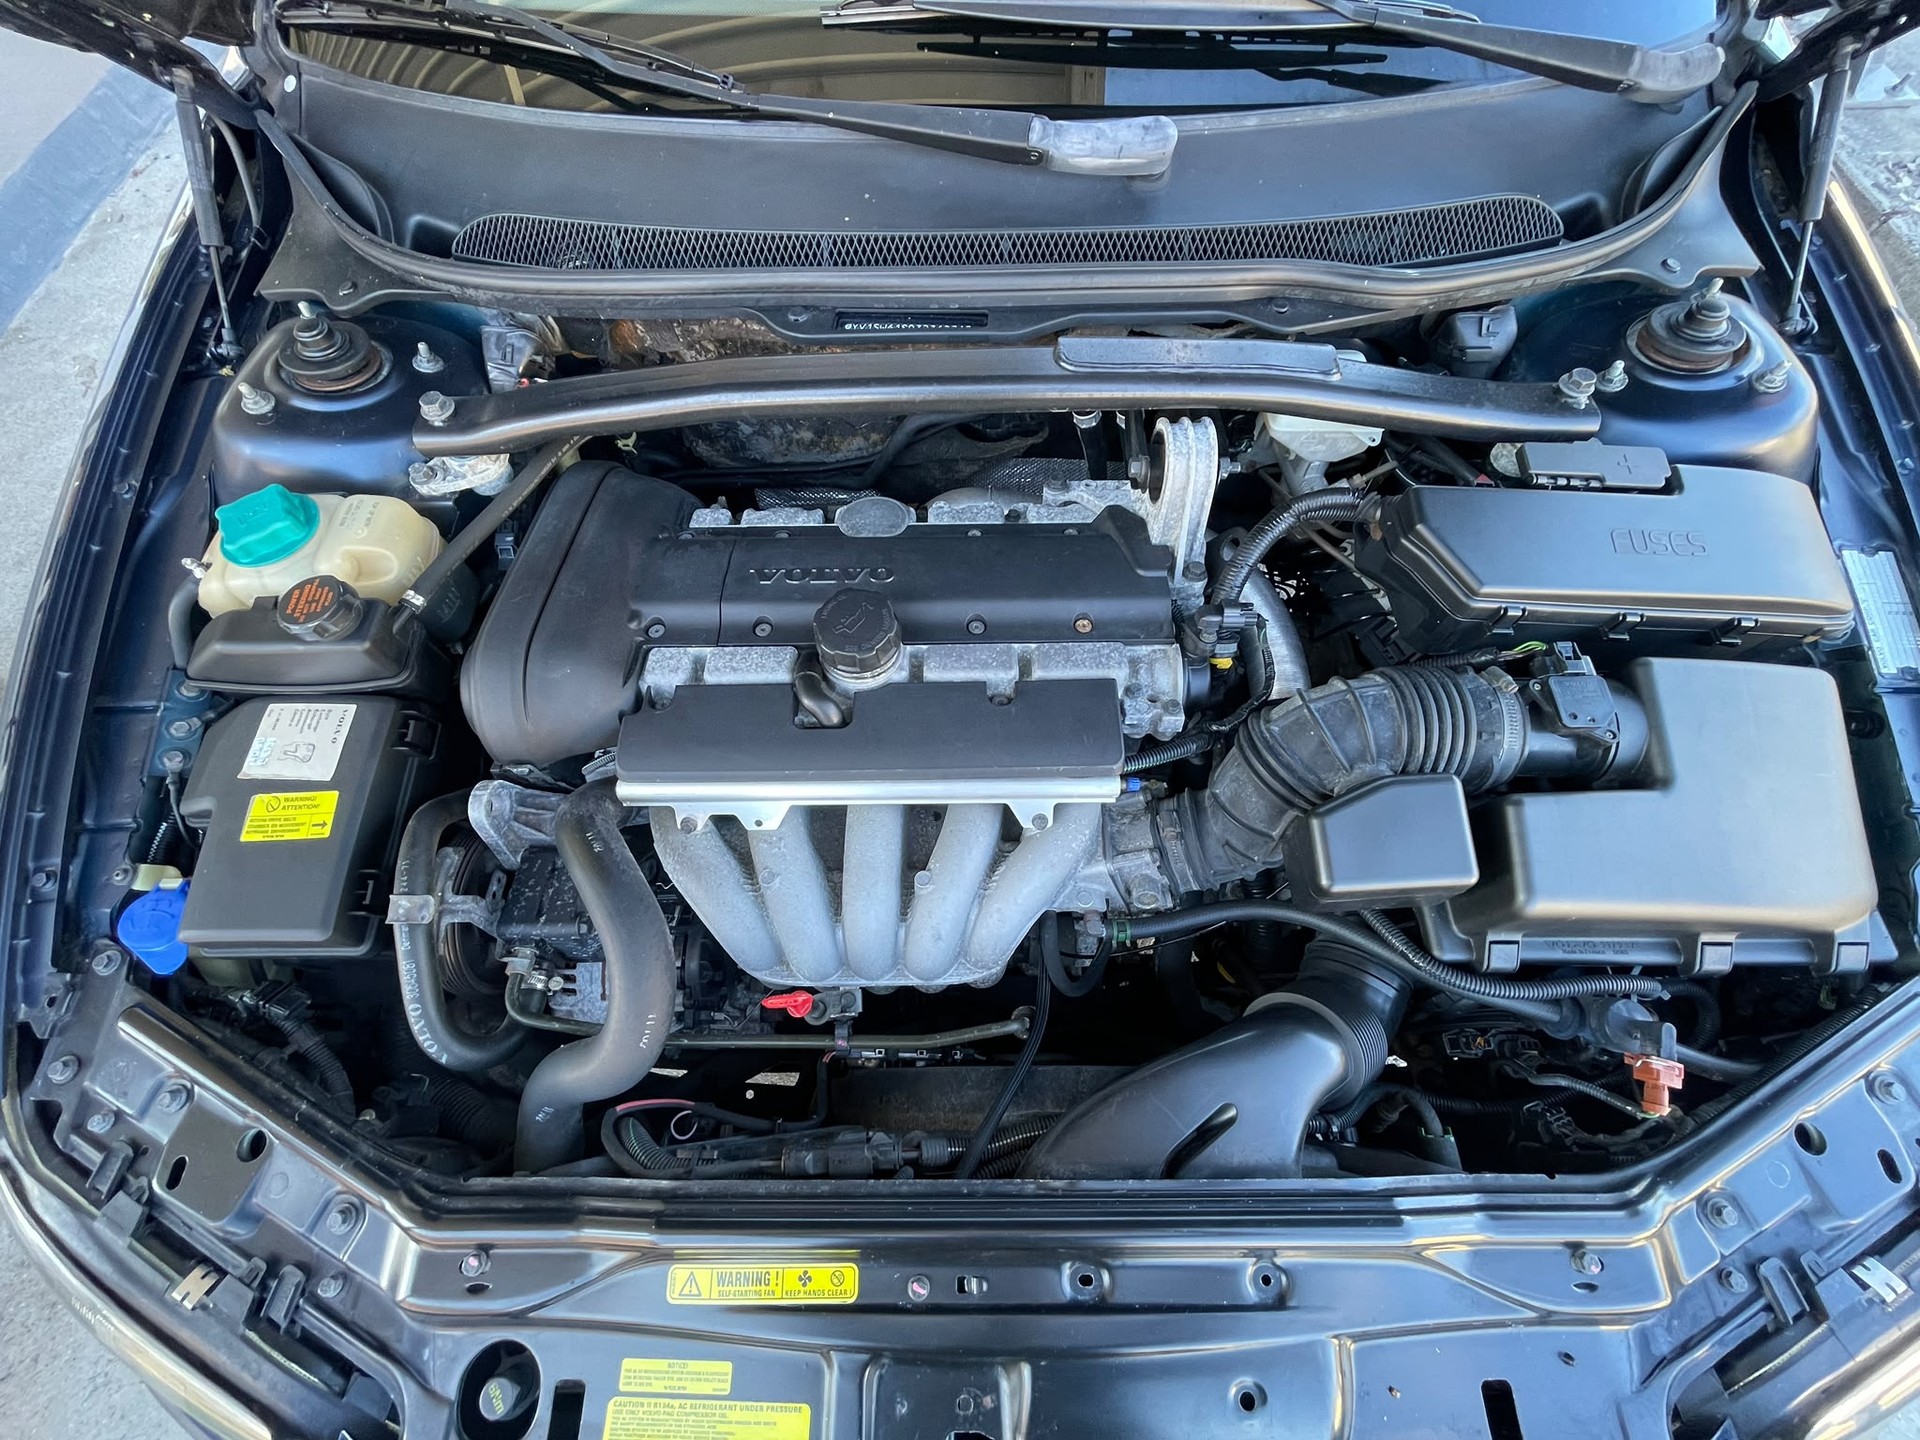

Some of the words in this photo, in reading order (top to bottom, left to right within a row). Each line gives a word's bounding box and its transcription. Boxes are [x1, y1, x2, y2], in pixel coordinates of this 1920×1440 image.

[1610, 529, 1708, 556] FUSES
[749, 567, 895, 584] VOLVO
[285, 589, 301, 614] POWER
[331, 709, 348, 744] VOLVO
[409, 1003, 448, 1065] VOLVO
[716, 1271, 770, 1287] WARNING
[775, 1271, 779, 1287] !
[718, 1289, 763, 1298] SELF-STARTING
[763, 1289, 776, 1297] FAN
[785, 1289, 801, 1297] KEEP
[803, 1289, 826, 1297] HANDS
[827, 1289, 848, 1297] CLEAR
[613, 1400, 645, 1409] CAUTION
[678, 1402, 689, 1410] AC
[689, 1403, 738, 1412] REFRIGERANT
[739, 1404, 764, 1413] UNDER
[765, 1405, 802, 1413] PRESSURE
